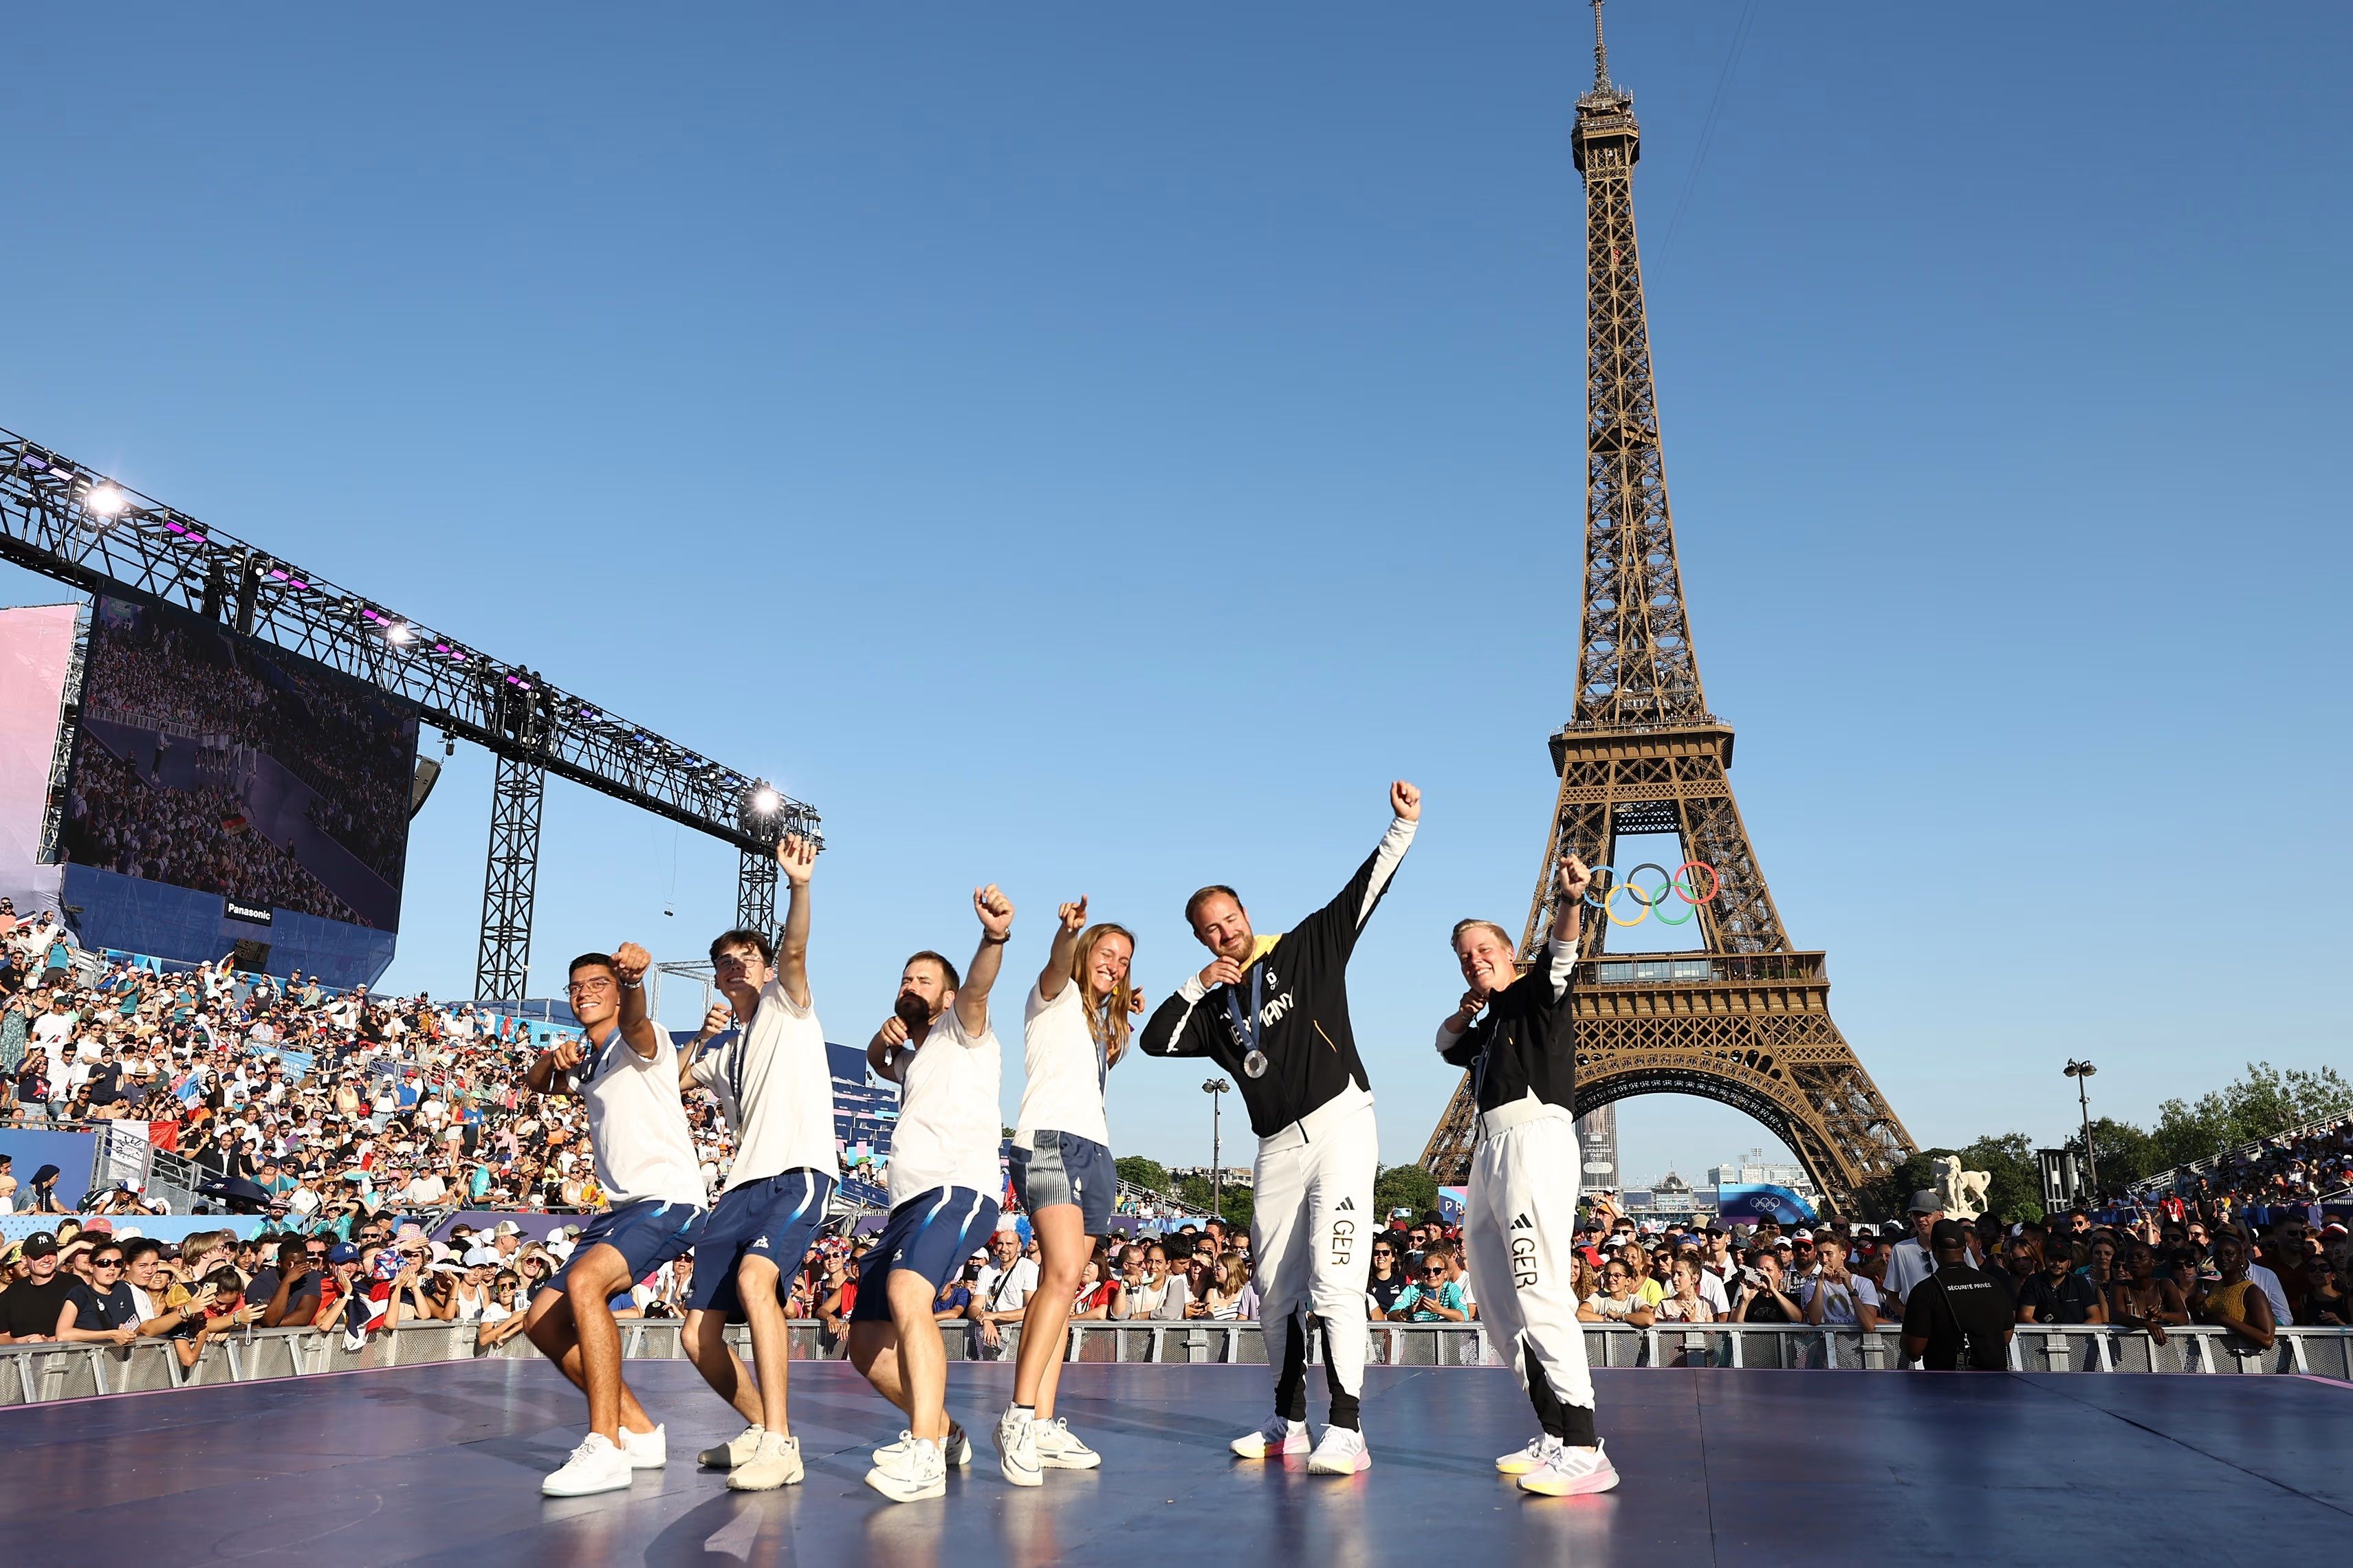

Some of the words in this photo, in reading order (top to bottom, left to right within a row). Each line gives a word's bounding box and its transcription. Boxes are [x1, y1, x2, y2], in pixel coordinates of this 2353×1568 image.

[228, 903, 271, 920] Panasonic
[1445, 1200, 1463, 1212] PA
[1331, 1219, 1355, 1266] GER
[1511, 1237, 1538, 1290] GER
